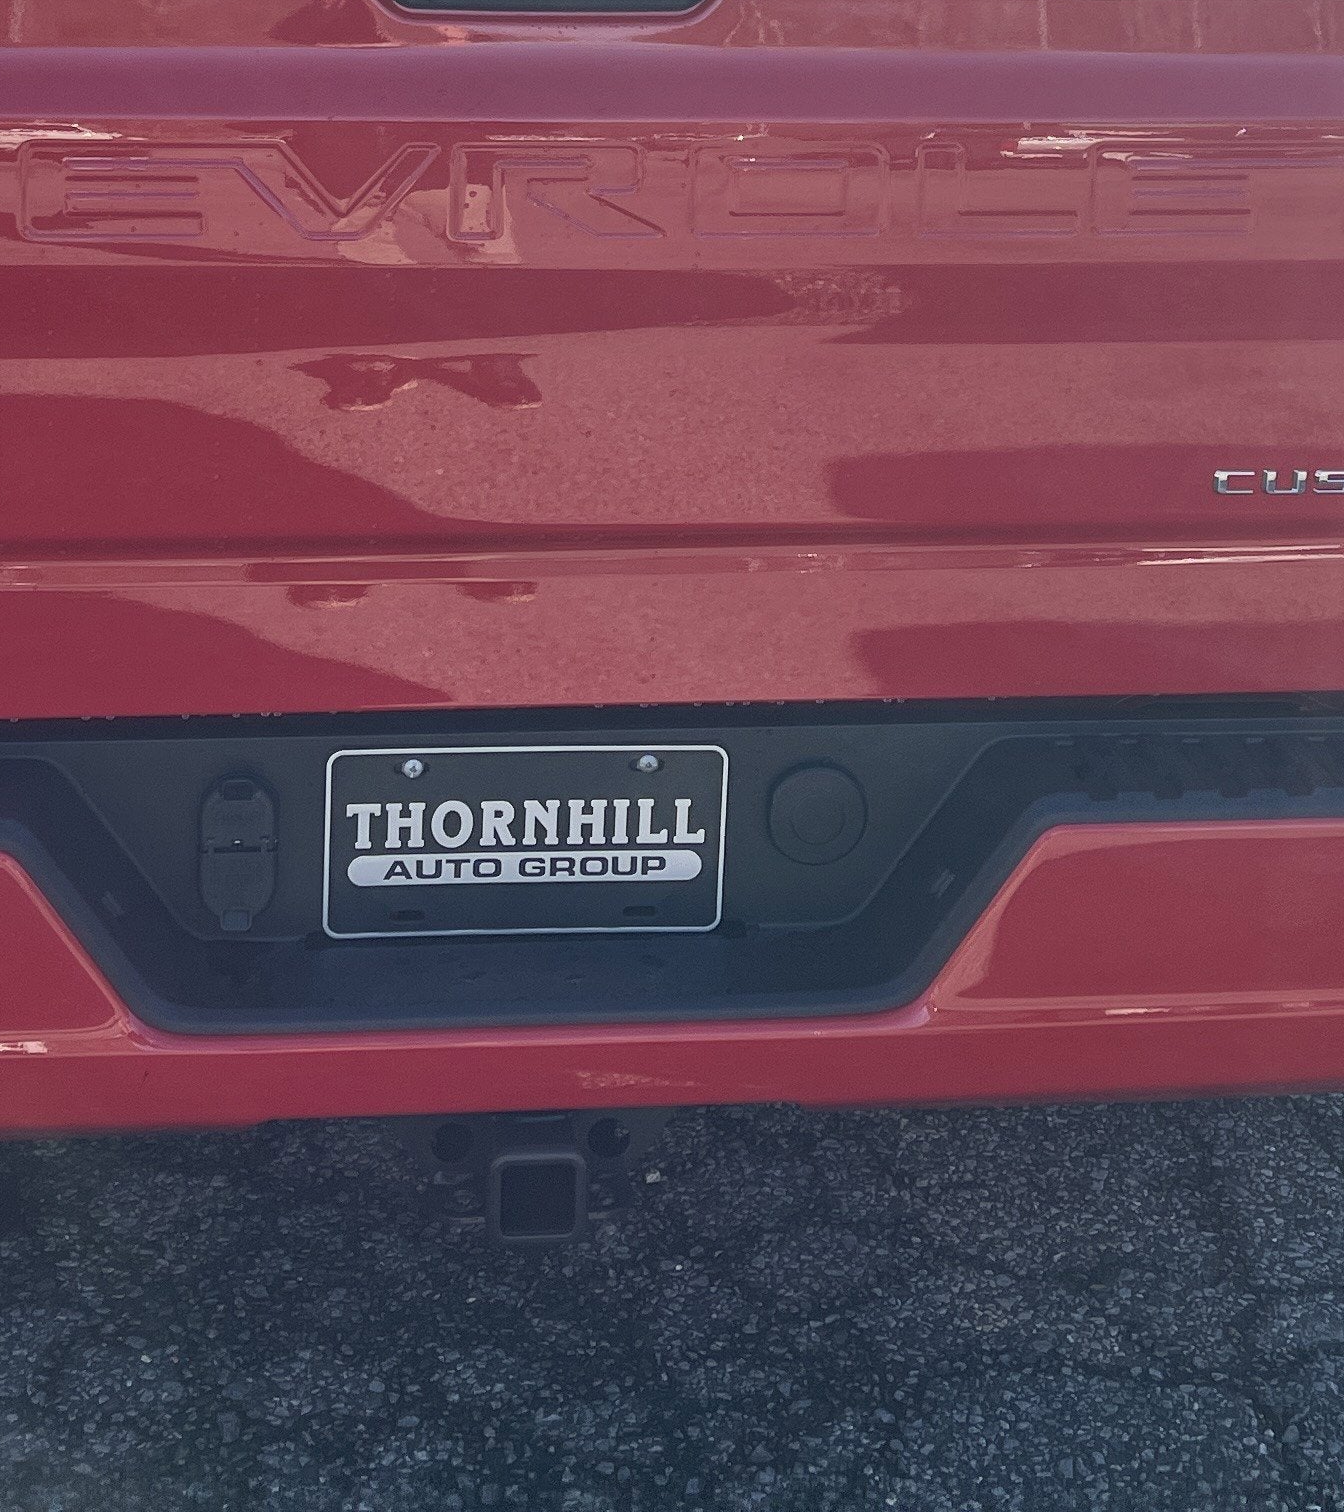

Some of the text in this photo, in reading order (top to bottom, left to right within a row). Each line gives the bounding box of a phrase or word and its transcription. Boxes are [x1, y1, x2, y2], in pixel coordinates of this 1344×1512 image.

[346, 798, 706, 850] THORNHILL
[383, 855, 667, 881] AUTO GROUP
